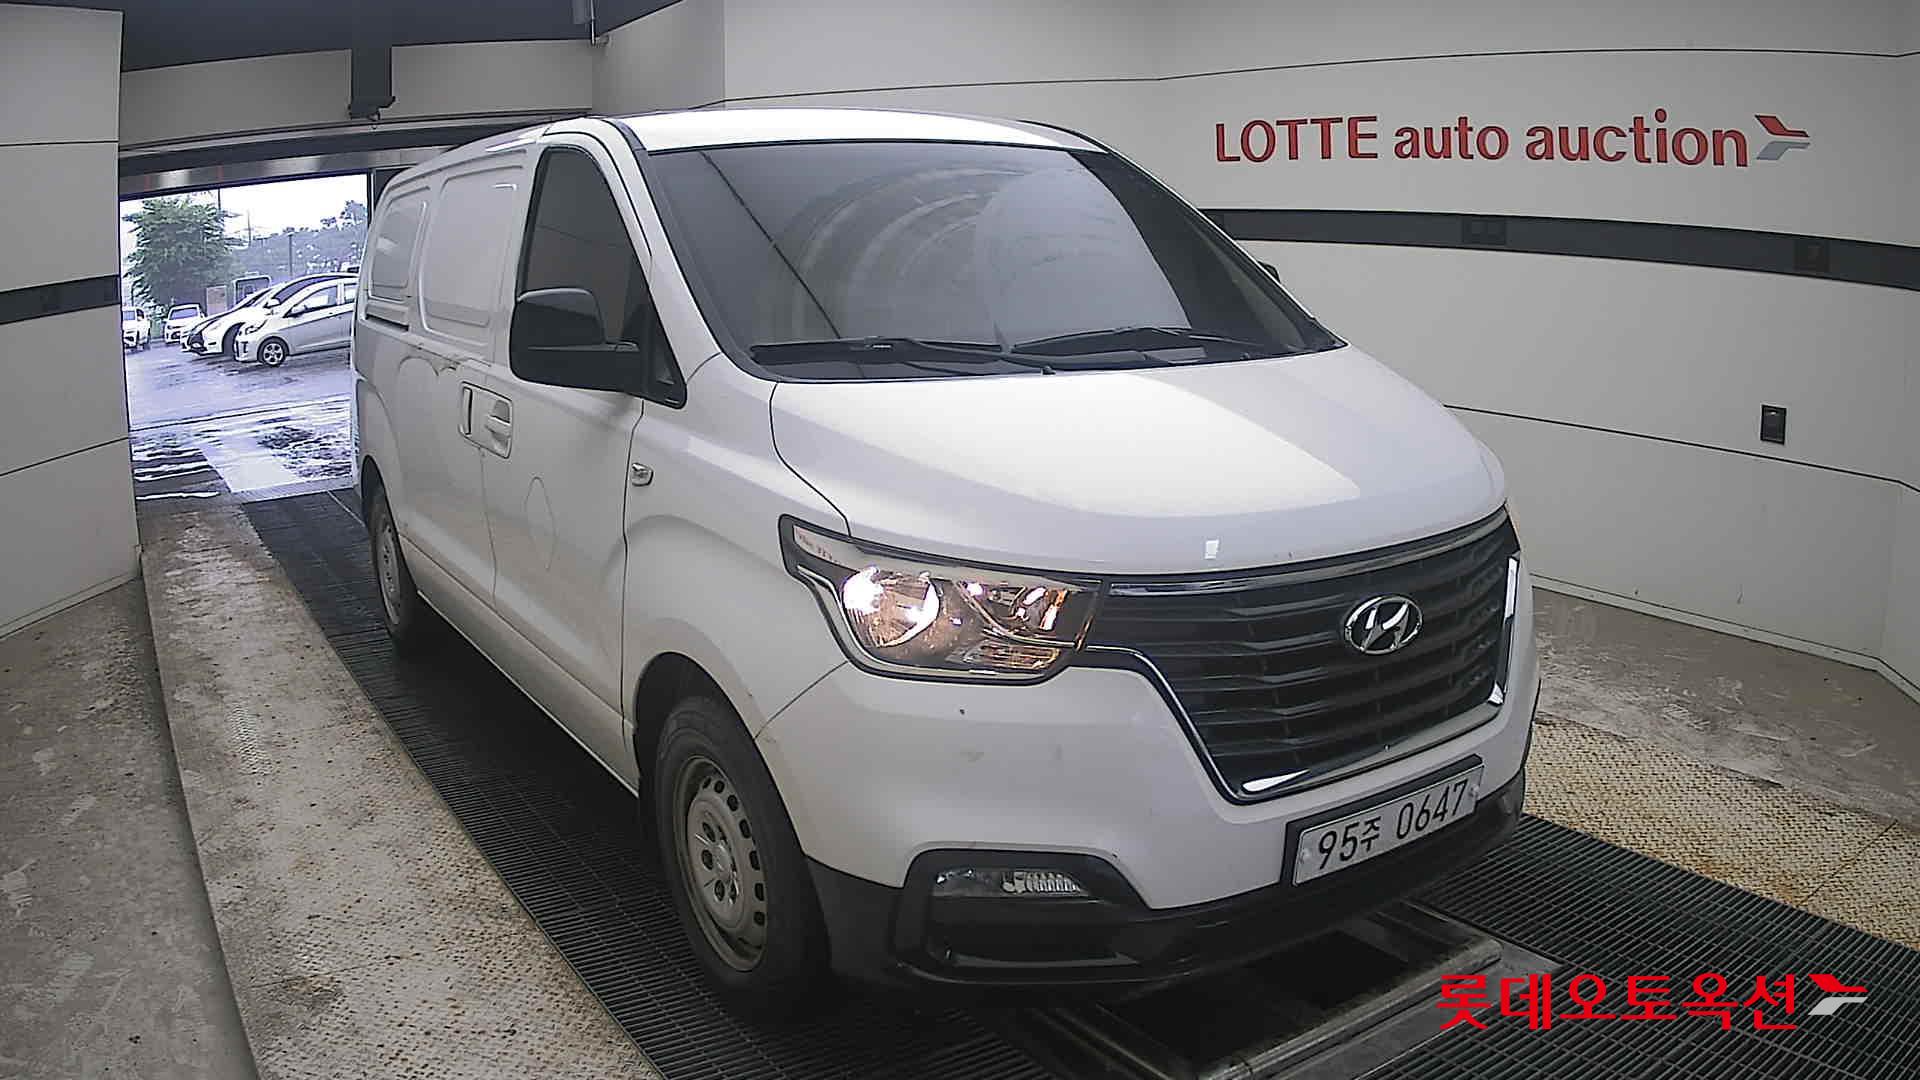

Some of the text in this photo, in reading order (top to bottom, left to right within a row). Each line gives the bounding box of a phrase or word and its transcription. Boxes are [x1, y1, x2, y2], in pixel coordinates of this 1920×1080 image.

[1215, 109, 1748, 167] LOTTE auto auction
[1318, 778, 1468, 870] 95주 0647
